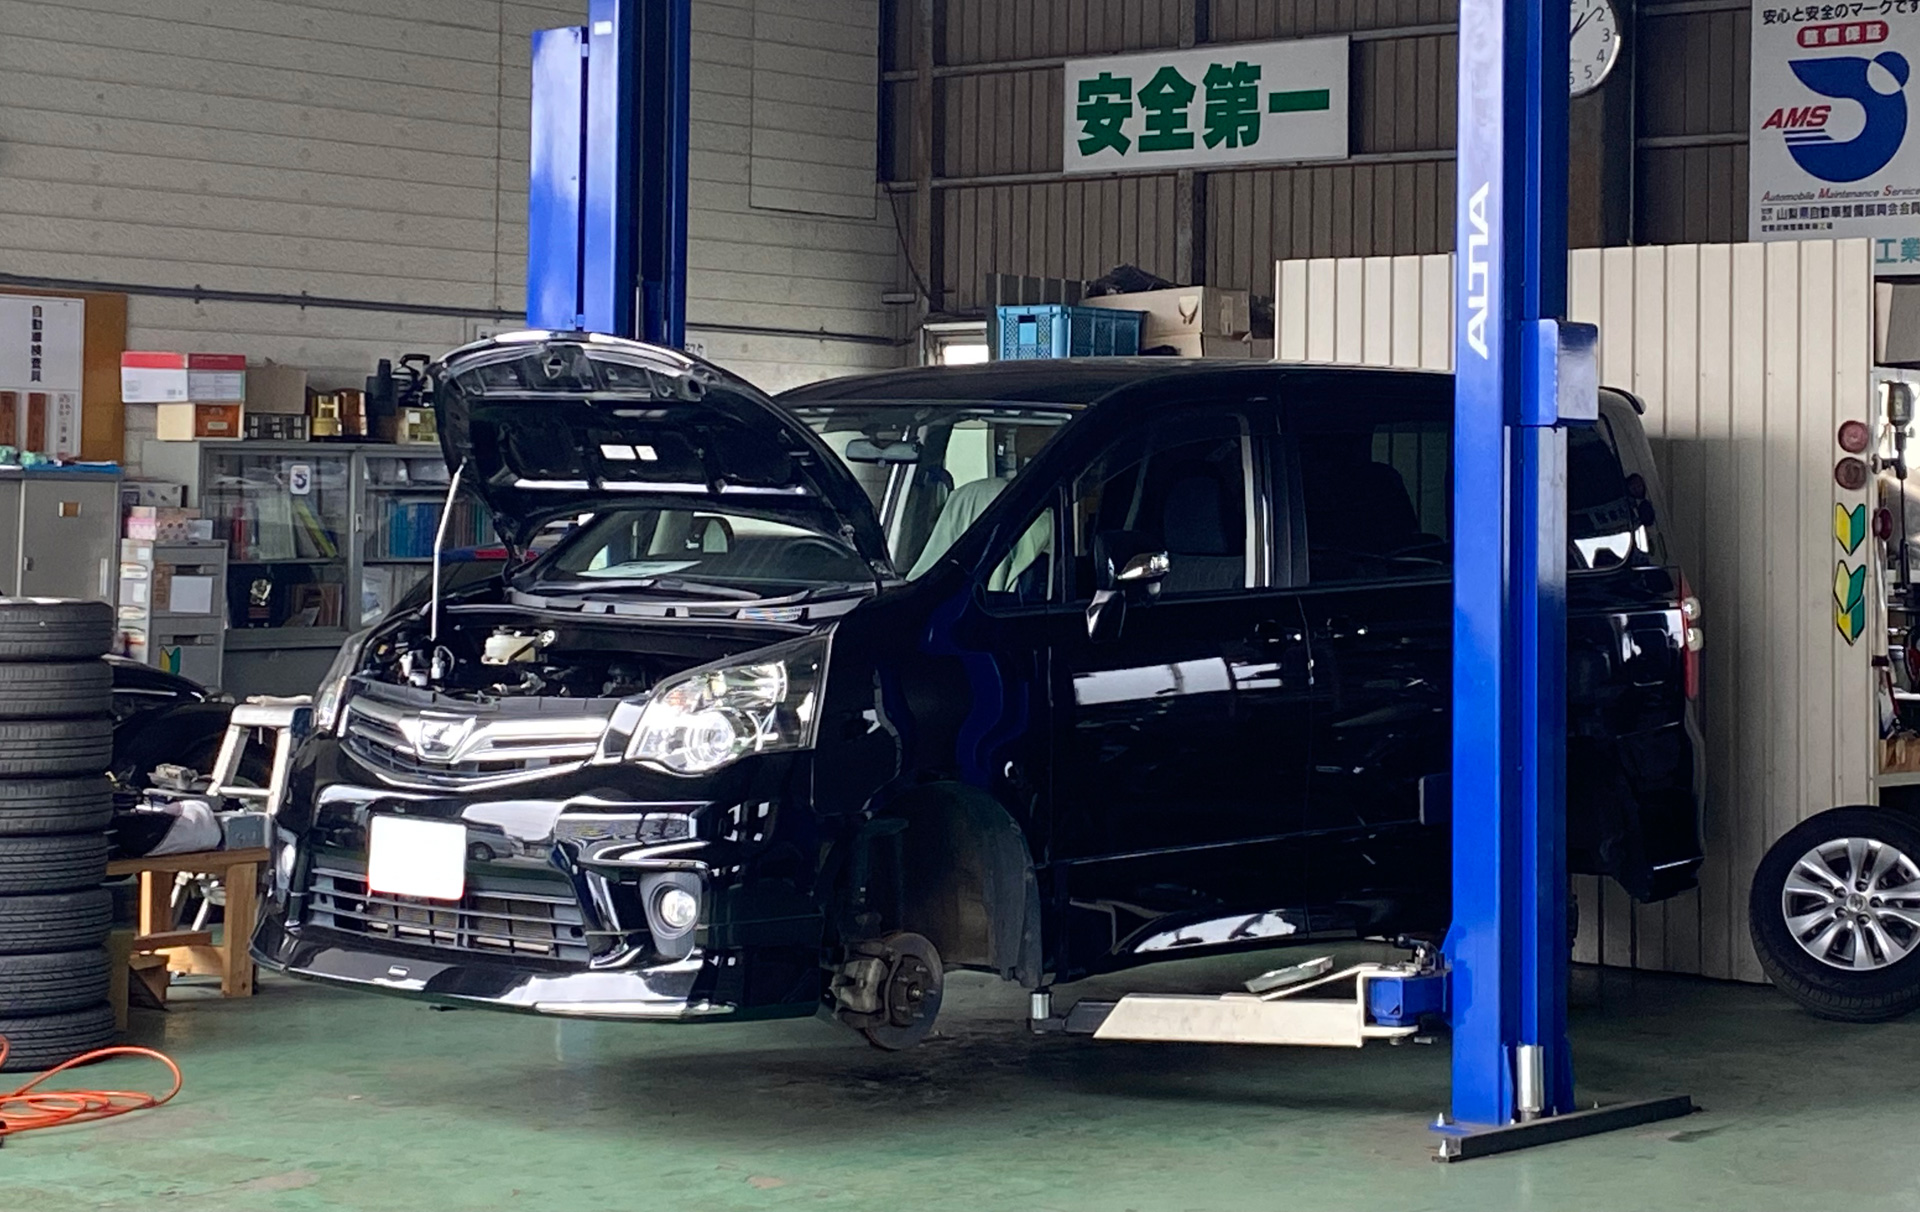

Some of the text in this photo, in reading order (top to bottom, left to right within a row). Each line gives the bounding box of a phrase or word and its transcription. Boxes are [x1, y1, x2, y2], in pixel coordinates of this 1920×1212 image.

[1763, 0, 1920, 25] 安心と安全のマークです
[1602, 28, 1610, 42] 3
[1597, 49, 1605, 62] 4
[1585, 65, 1592, 79] 5
[1077, 61, 1330, 157] 安全第一
[1761, 105, 1832, 130] AMS
[1876, 237, 1920, 264] 工業
[1468, 181, 1489, 360] ALTIA
